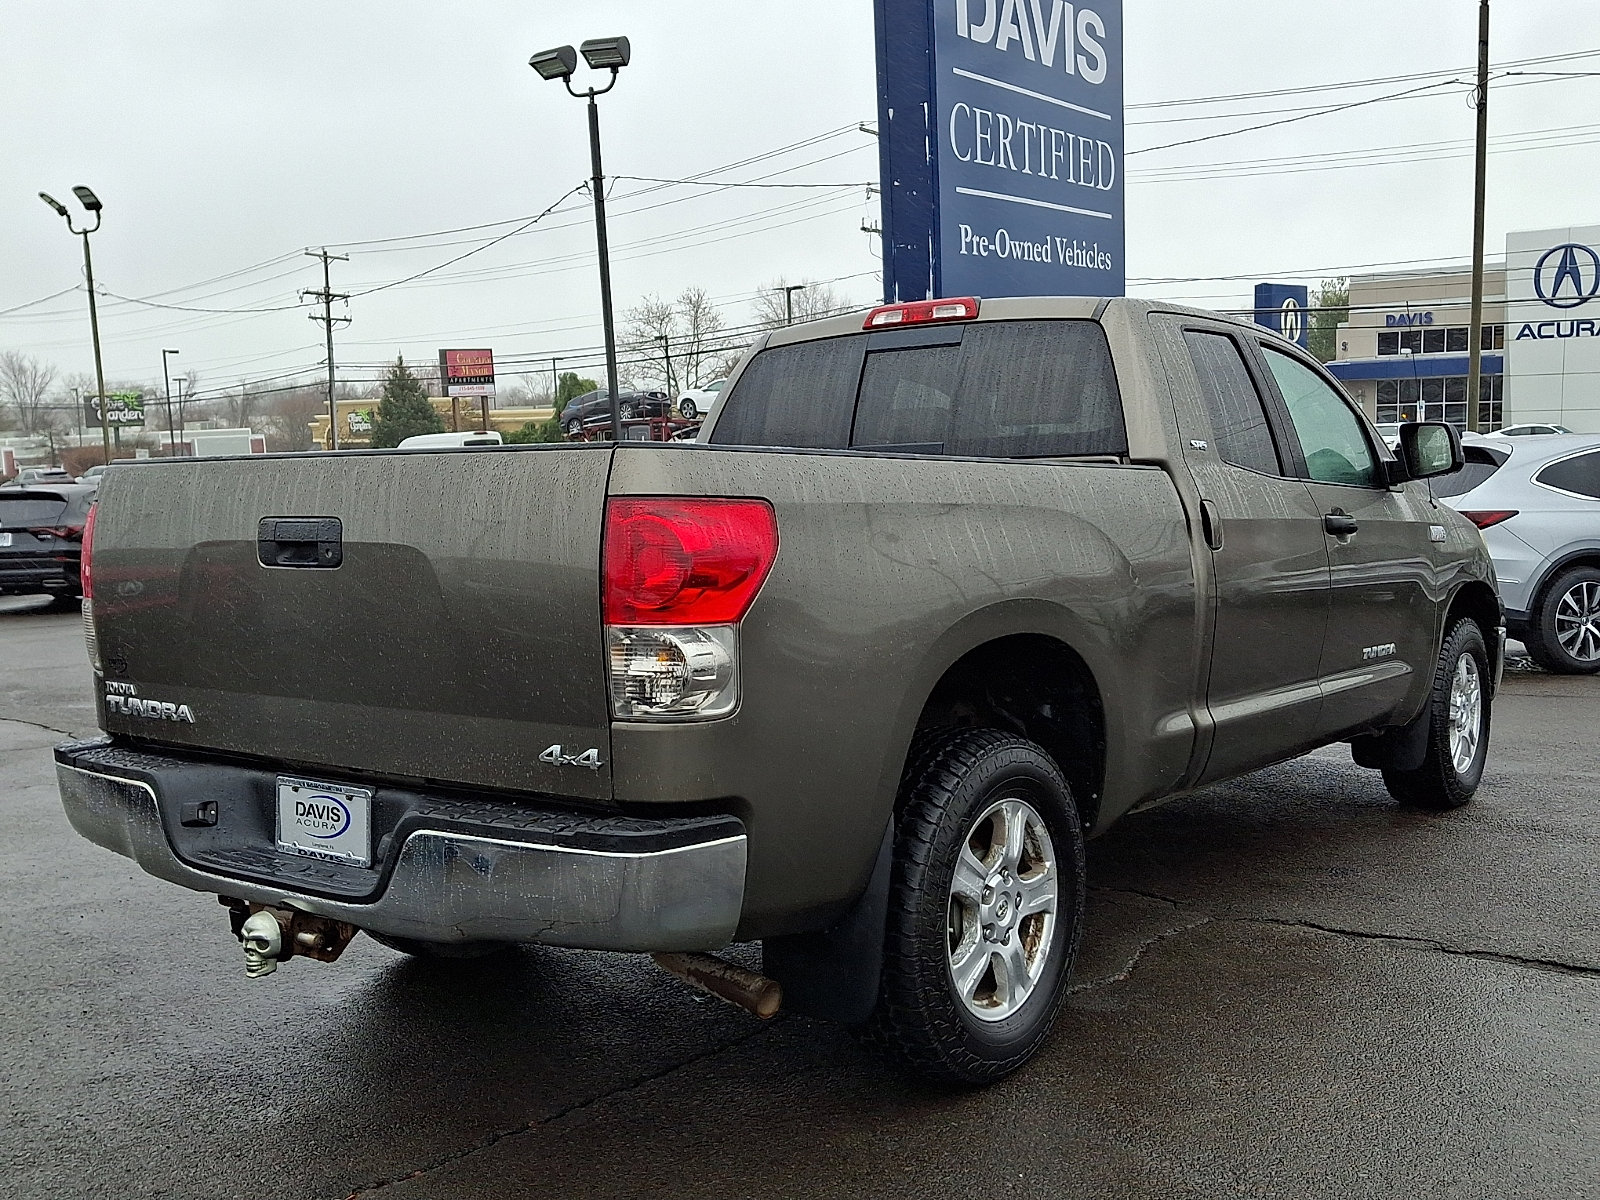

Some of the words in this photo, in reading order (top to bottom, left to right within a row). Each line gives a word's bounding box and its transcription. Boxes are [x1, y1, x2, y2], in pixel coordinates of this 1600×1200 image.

[950, 102, 1115, 191] CERTIFIED
[958, 223, 1052, 263] Pre-Owned
[1055, 236, 1112, 271] Vehicles
[1386, 311, 1433, 328] DAVIS
[1515, 320, 1600, 340] ACUR
[91, 396, 125, 410] Oive
[105, 681, 136, 696] TOYOTA
[106, 694, 195, 724] TUNDRA
[539, 744, 604, 769] 4x4
[296, 801, 340, 823] DAVIS
[296, 818, 337, 831] ACURA
[298, 848, 344, 862] DAVIS
